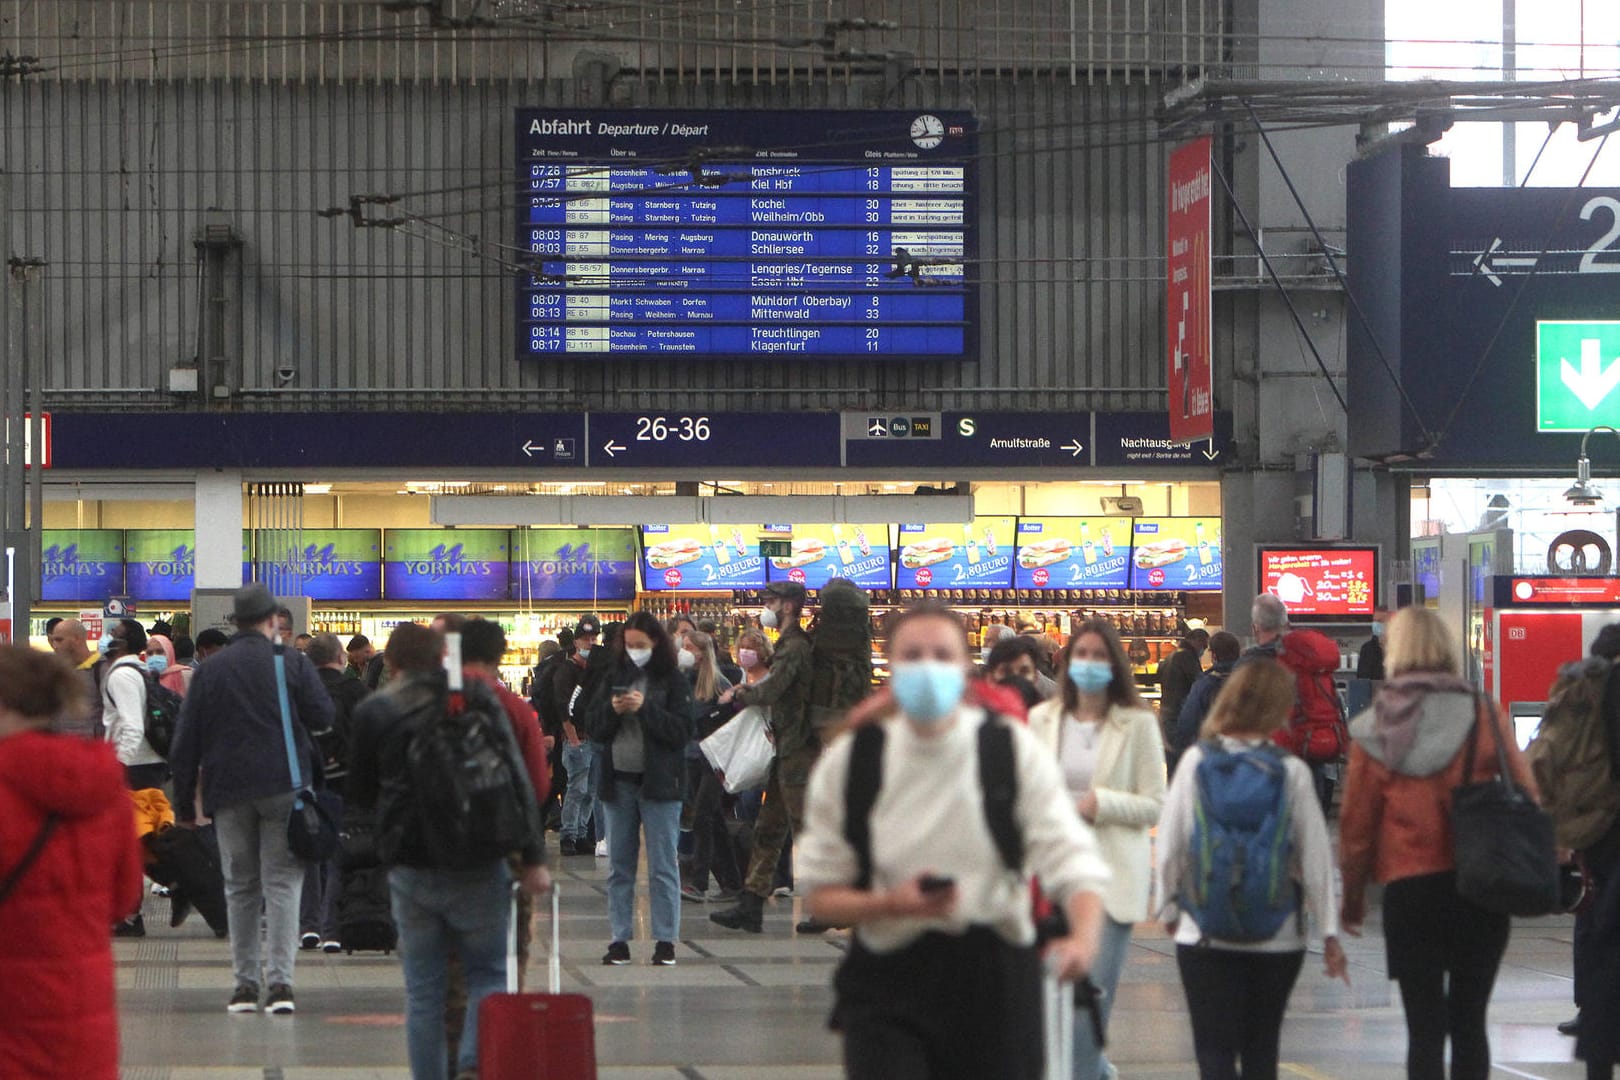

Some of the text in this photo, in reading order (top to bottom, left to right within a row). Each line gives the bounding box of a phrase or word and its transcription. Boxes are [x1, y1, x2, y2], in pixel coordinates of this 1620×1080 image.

[529, 119, 592, 136] Abfahrt
[597, 123, 709, 137] Departure Départ
[751, 167, 800, 177] Innsbruck
[866, 167, 880, 177] 13
[532, 178, 560, 188] 07:57
[611, 182, 644, 190] Augsburg
[751, 180, 793, 190] Kiel Hbf
[866, 180, 880, 190] 18
[611, 201, 717, 210] Pasing Starnberg Tutzing
[751, 199, 786, 209] Kochel
[866, 200, 880, 210] 30
[611, 214, 717, 223] Pasing Starnberg Tutzing
[751, 211, 825, 222] Weilheim/Obb
[866, 212, 880, 222] 30
[532, 230, 560, 240] 08:03
[611, 233, 714, 243] Pasing Mering Augsburg
[751, 231, 814, 242] Donauwörth
[866, 231, 880, 242] 16
[532, 243, 560, 253] 08:03
[611, 246, 706, 255] Donnersbergerbr. Harras
[751, 244, 805, 254] Schliersee
[866, 244, 880, 255] 32
[611, 266, 670, 274] Donnersbergerbr.
[751, 263, 853, 277] Lenggries/Tegernse
[866, 264, 880, 274] 32
[751, 276, 804, 287] Essen Hbf
[866, 276, 880, 287] 22
[532, 295, 560, 305] 08:07
[611, 298, 707, 306] Markt Schwaben Dorfen
[751, 295, 852, 309] Mühldorf (Oberbay)
[872, 296, 880, 306] 8
[532, 307, 560, 318] 08:13
[566, 309, 577, 317] RE
[611, 311, 714, 319] Pasing Weilheim Murnau
[751, 308, 810, 319] Mittenwald
[866, 309, 880, 319] 33
[532, 327, 560, 337] 08:14
[611, 330, 695, 338] Dachau Petershausen
[752, 327, 821, 341] Treuchtlingen
[866, 328, 880, 339] 20
[532, 340, 560, 350] 08:17
[611, 343, 696, 351] Rosenheim Traunstein
[751, 340, 806, 353] Klagenfurt
[866, 341, 879, 351] 11
[636, 417, 711, 441] 26-36
[893, 423, 907, 431] Bus
[914, 423, 929, 431] TAXI
[959, 418, 975, 436] S
[990, 437, 1051, 449] Arnulfstraße
[404, 561, 491, 576] YORMA'S
[531, 561, 617, 576] YORMA'S
[733, 556, 761, 573] EURO
[857, 556, 885, 573] EURO
[983, 556, 1009, 571] EURO
[1099, 556, 1125, 572] EURO
[44, 561, 106, 577] RMA'S
[1510, 628, 1526, 639] DB
